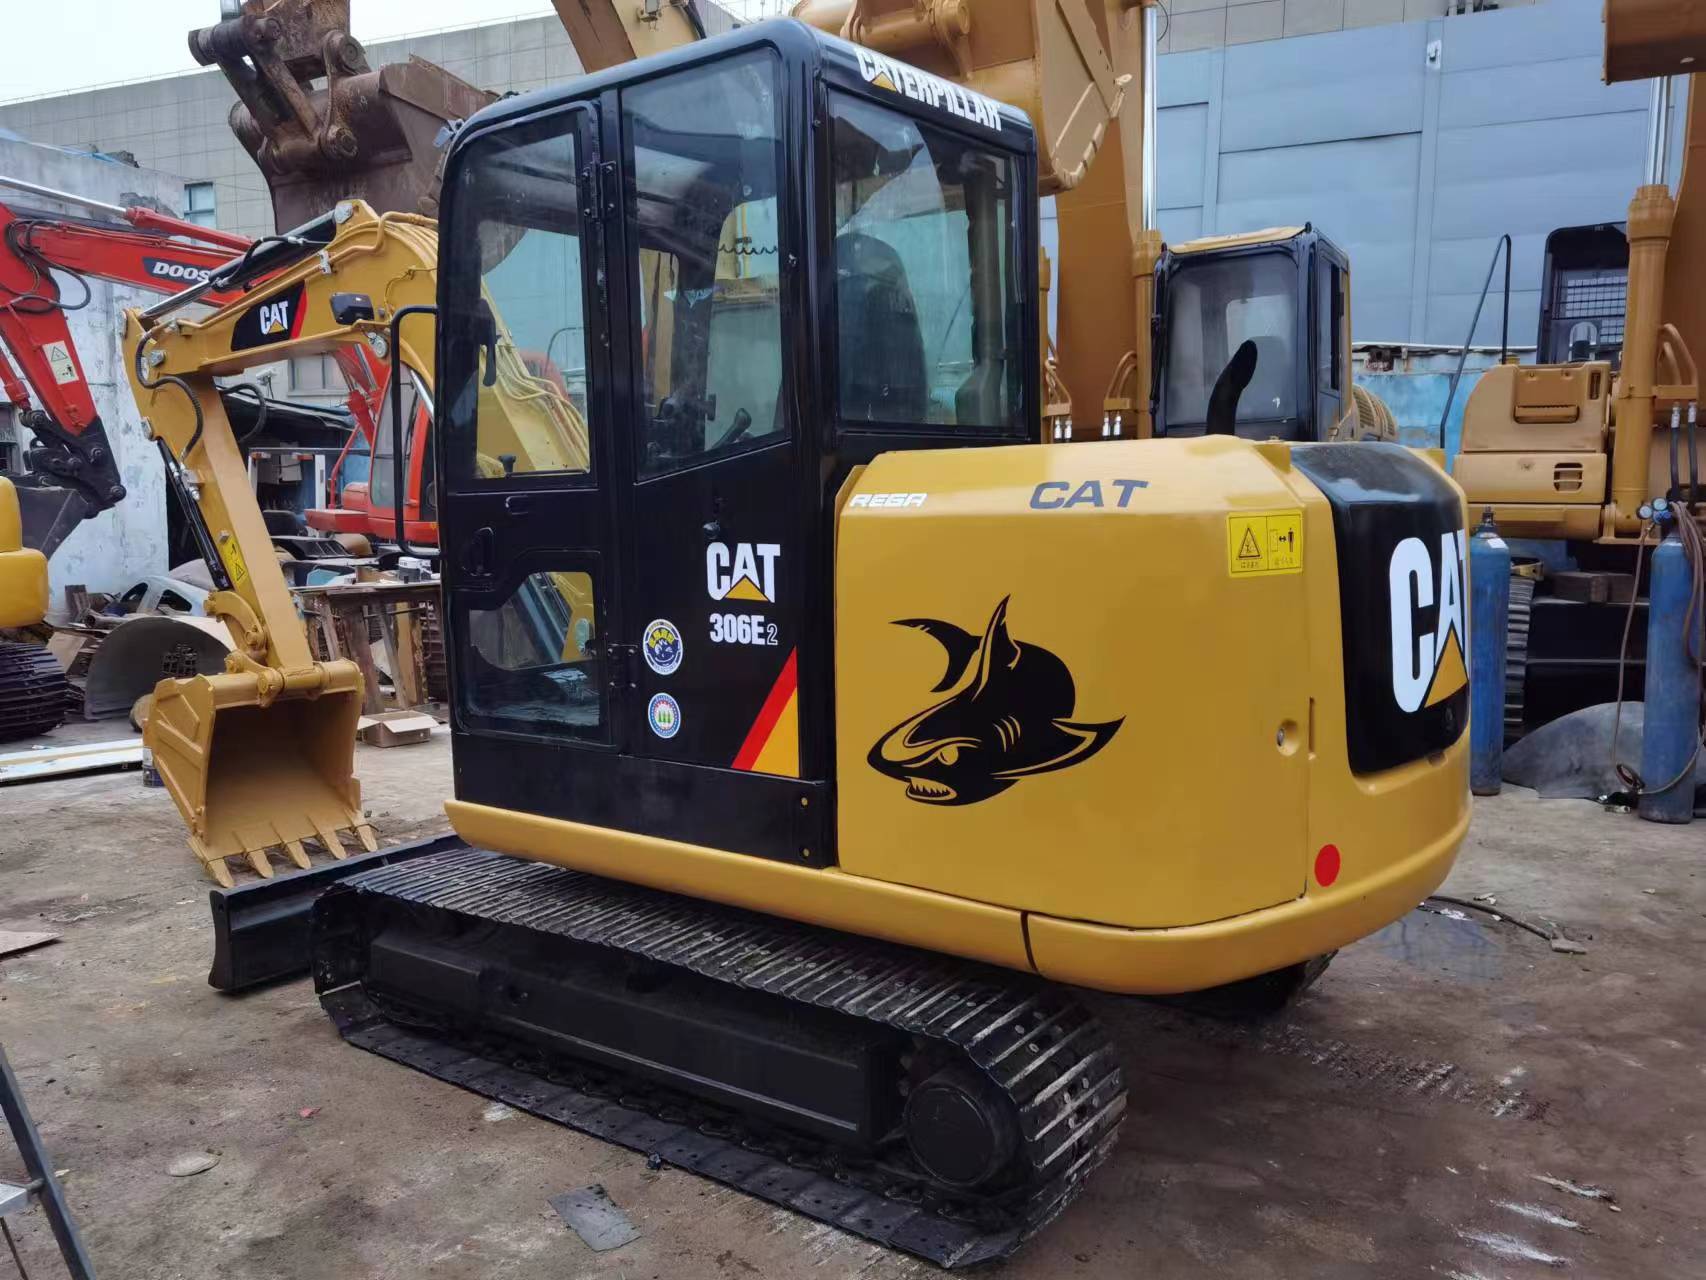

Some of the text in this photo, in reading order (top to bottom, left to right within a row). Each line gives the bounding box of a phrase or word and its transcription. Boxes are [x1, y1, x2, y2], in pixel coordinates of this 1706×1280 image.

[853, 46, 1002, 131] CATERPILLAR
[259, 300, 289, 335] CAT
[1029, 480, 1149, 510] CAT
[706, 541, 781, 603] CAT
